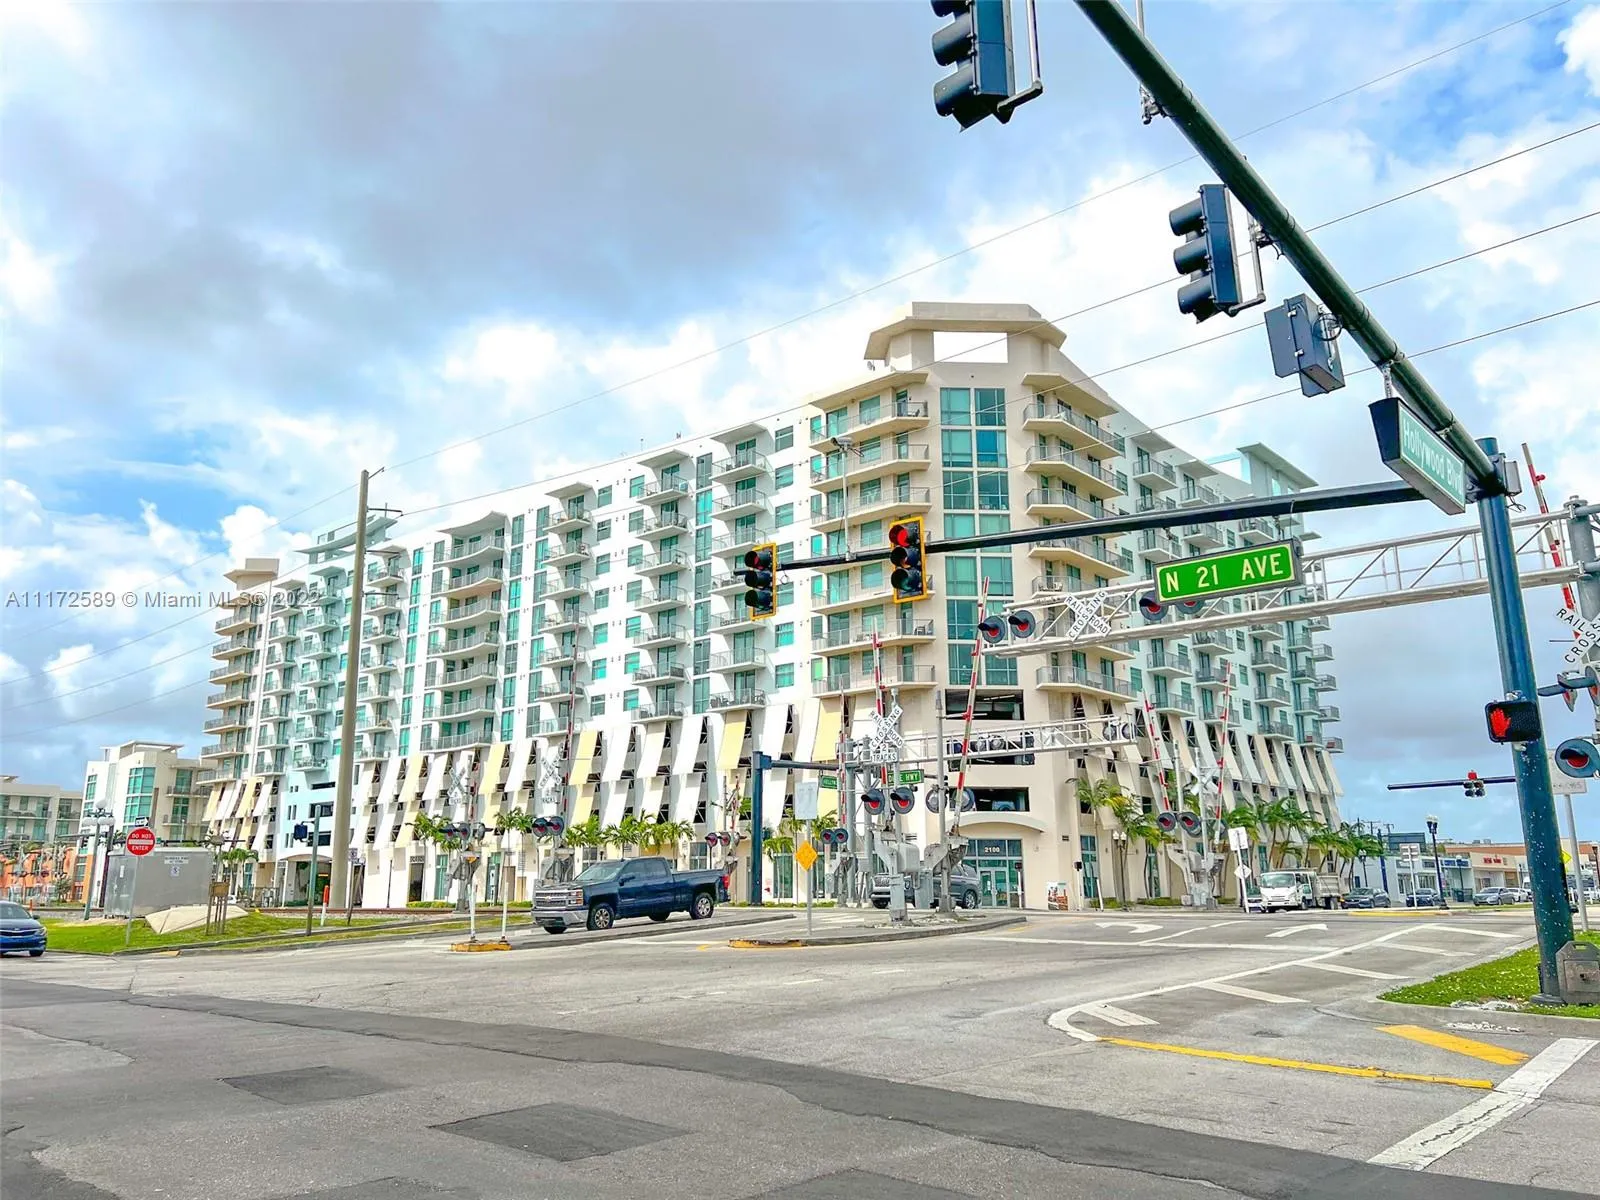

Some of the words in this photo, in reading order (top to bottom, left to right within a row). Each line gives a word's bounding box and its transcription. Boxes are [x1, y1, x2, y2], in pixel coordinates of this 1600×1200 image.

[1403, 418, 1445, 479] Hollywood
[1447, 457, 1463, 496] Blvd
[1165, 571, 1179, 593] N
[1196, 564, 1219, 588] 21
[1242, 553, 1283, 580] AVE
[1066, 596, 1083, 615] RAIL
[1089, 615, 1108, 635] ROAD
[1068, 591, 1106, 638] CROSSING
[1556, 608, 1585, 632] RAIL
[1564, 617, 1600, 663] CROSS
[871, 706, 901, 748] CROSSING
[888, 729, 903, 747] ROAD
[872, 753, 897, 761] TRACKS
[882, 744, 887, 752] 2
[905, 773, 919, 781] HWY
